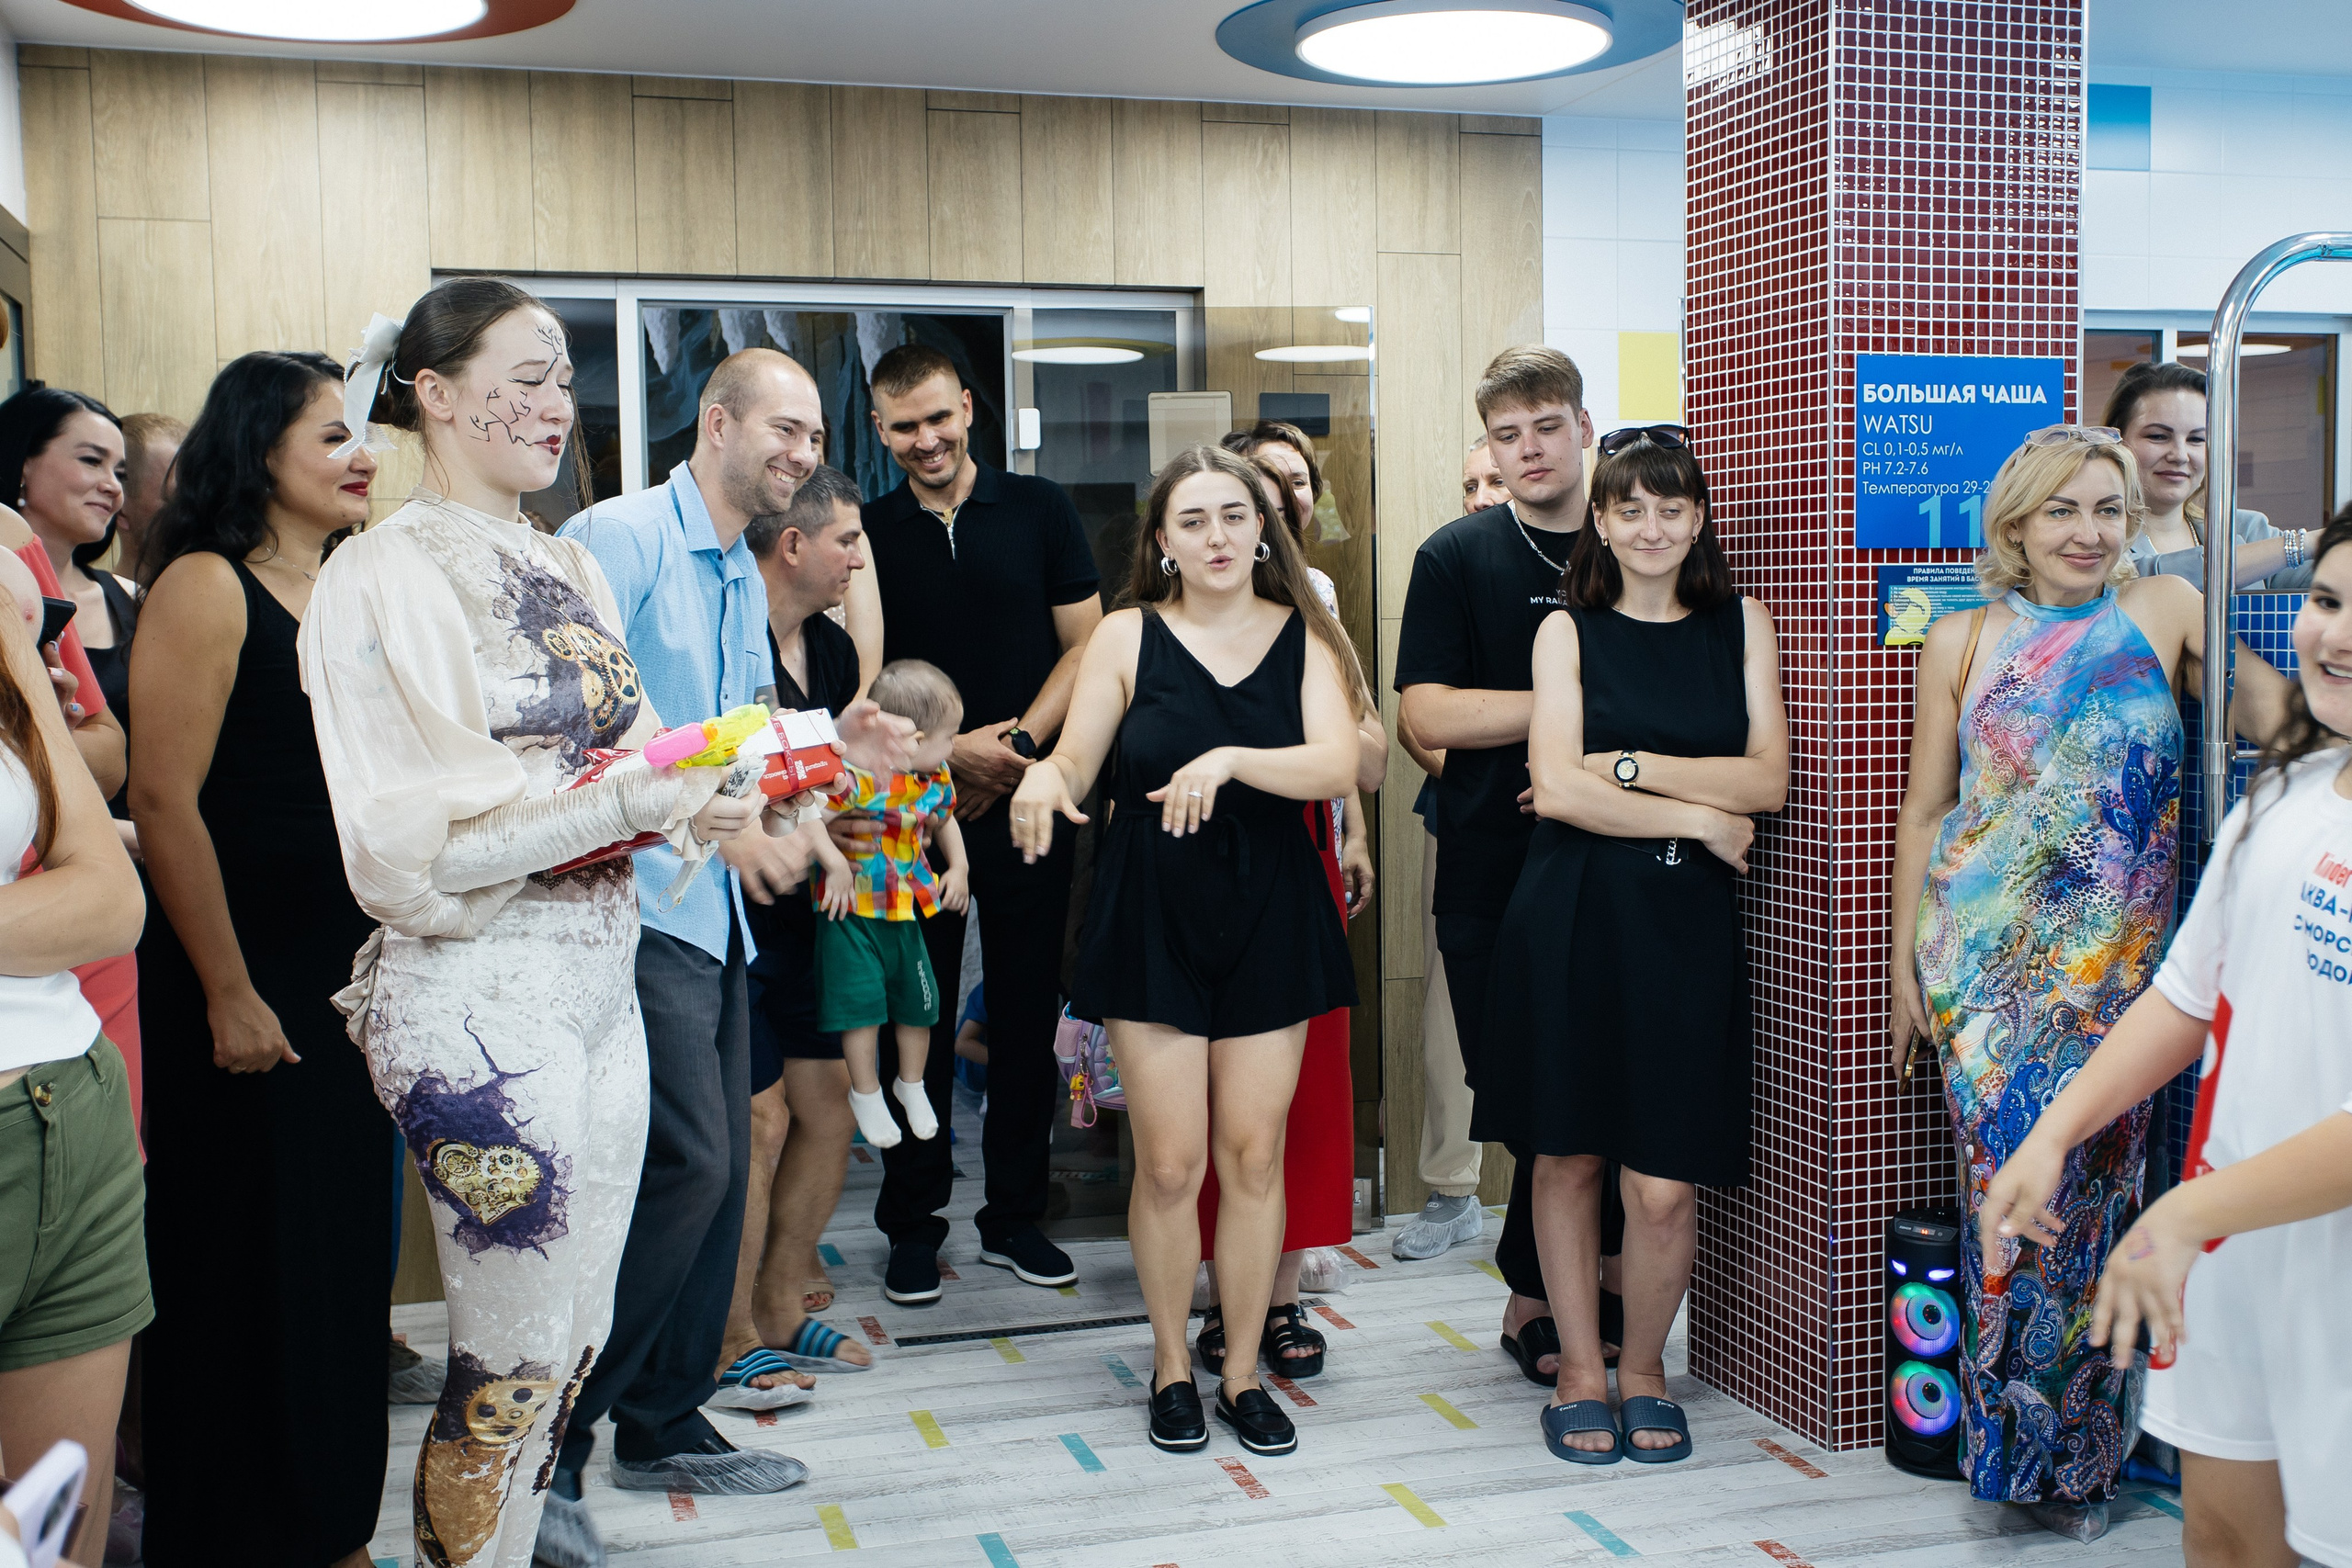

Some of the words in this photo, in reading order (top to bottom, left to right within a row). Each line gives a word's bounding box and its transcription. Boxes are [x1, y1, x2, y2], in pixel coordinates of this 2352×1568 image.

[1862, 383, 1975, 404] БОЛЬШАЯ
[1981, 384, 2048, 404] ЧАША
[1862, 413, 1933, 435] WATSU
[1862, 442, 1881, 456] CL
[1883, 442, 1928, 457] 0,1-0,5
[1931, 442, 1964, 457] мг/л
[1862, 461, 1881, 475] PH
[1884, 461, 1928, 475] 7.2-7.6
[1861, 480, 1959, 497] Температура
[1929, 574, 1960, 582] ЗАНЯТИЙ
[1945, 567, 1976, 575] ПОВЕДЕН
[1530, 596, 1544, 604] MY
[778, 732, 796, 776] БОКСЫ
